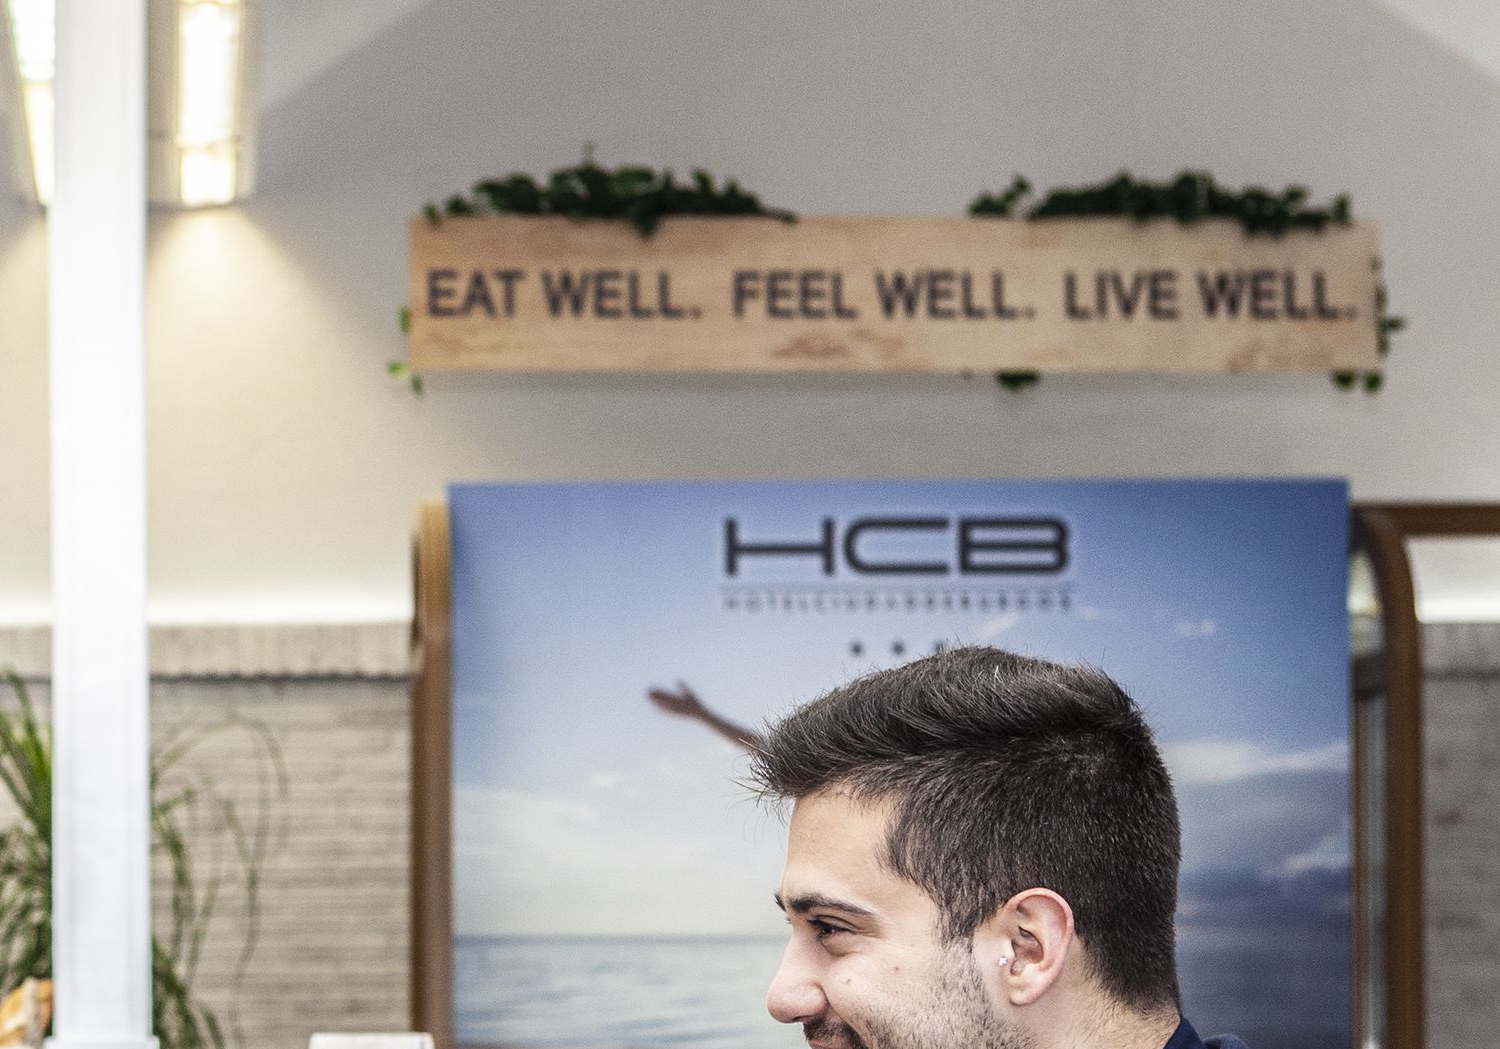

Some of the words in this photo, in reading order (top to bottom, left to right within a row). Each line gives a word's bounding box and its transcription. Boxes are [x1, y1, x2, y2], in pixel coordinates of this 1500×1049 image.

[426, 267, 526, 319] EAT
[540, 267, 702, 319] WELL.
[731, 267, 858, 319] FEEL
[874, 267, 1037, 320] WELL.
[1062, 267, 1180, 320] LIVE
[1196, 267, 1359, 320] WELL.
[723, 516, 1071, 577] HCB
